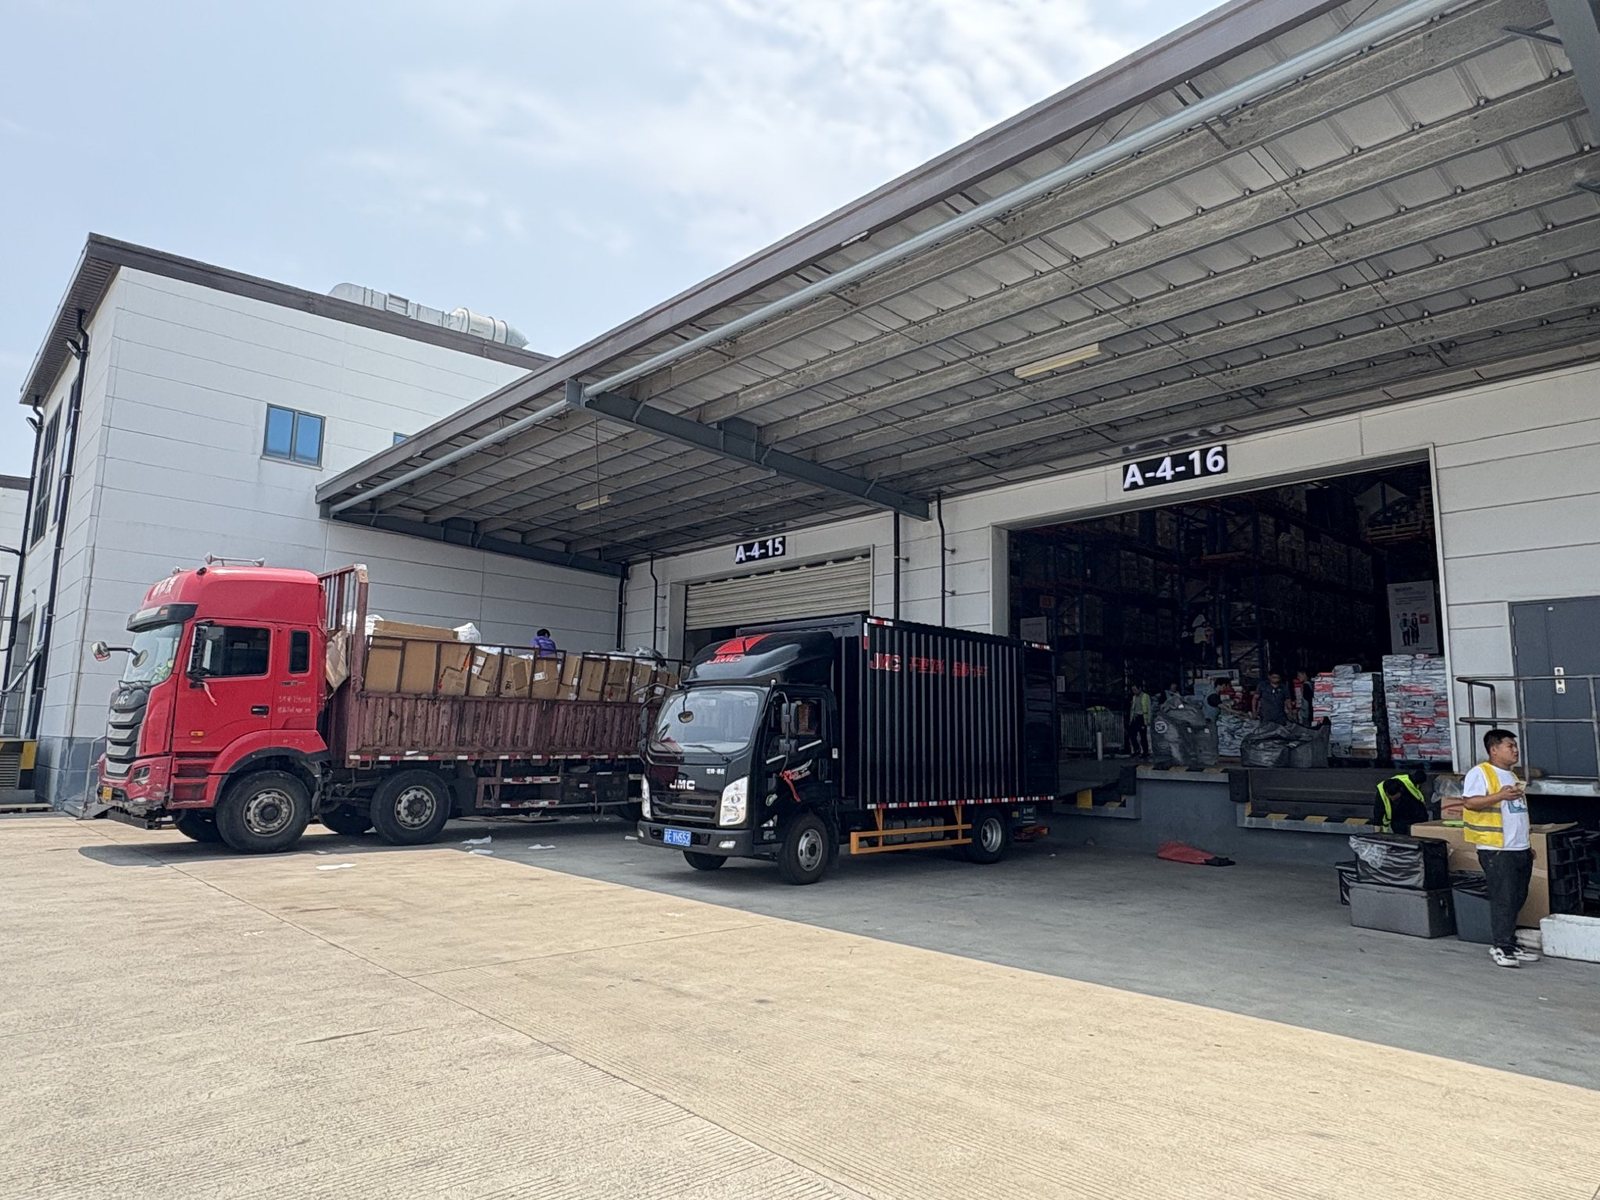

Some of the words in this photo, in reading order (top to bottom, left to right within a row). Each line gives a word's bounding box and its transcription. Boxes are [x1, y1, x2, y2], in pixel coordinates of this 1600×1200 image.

[1123, 446, 1225, 489] A-4-16
[735, 537, 783, 562] A-4-15
[706, 654, 745, 664] JMC
[869, 652, 901, 672] JMC
[669, 779, 696, 790] JMC
